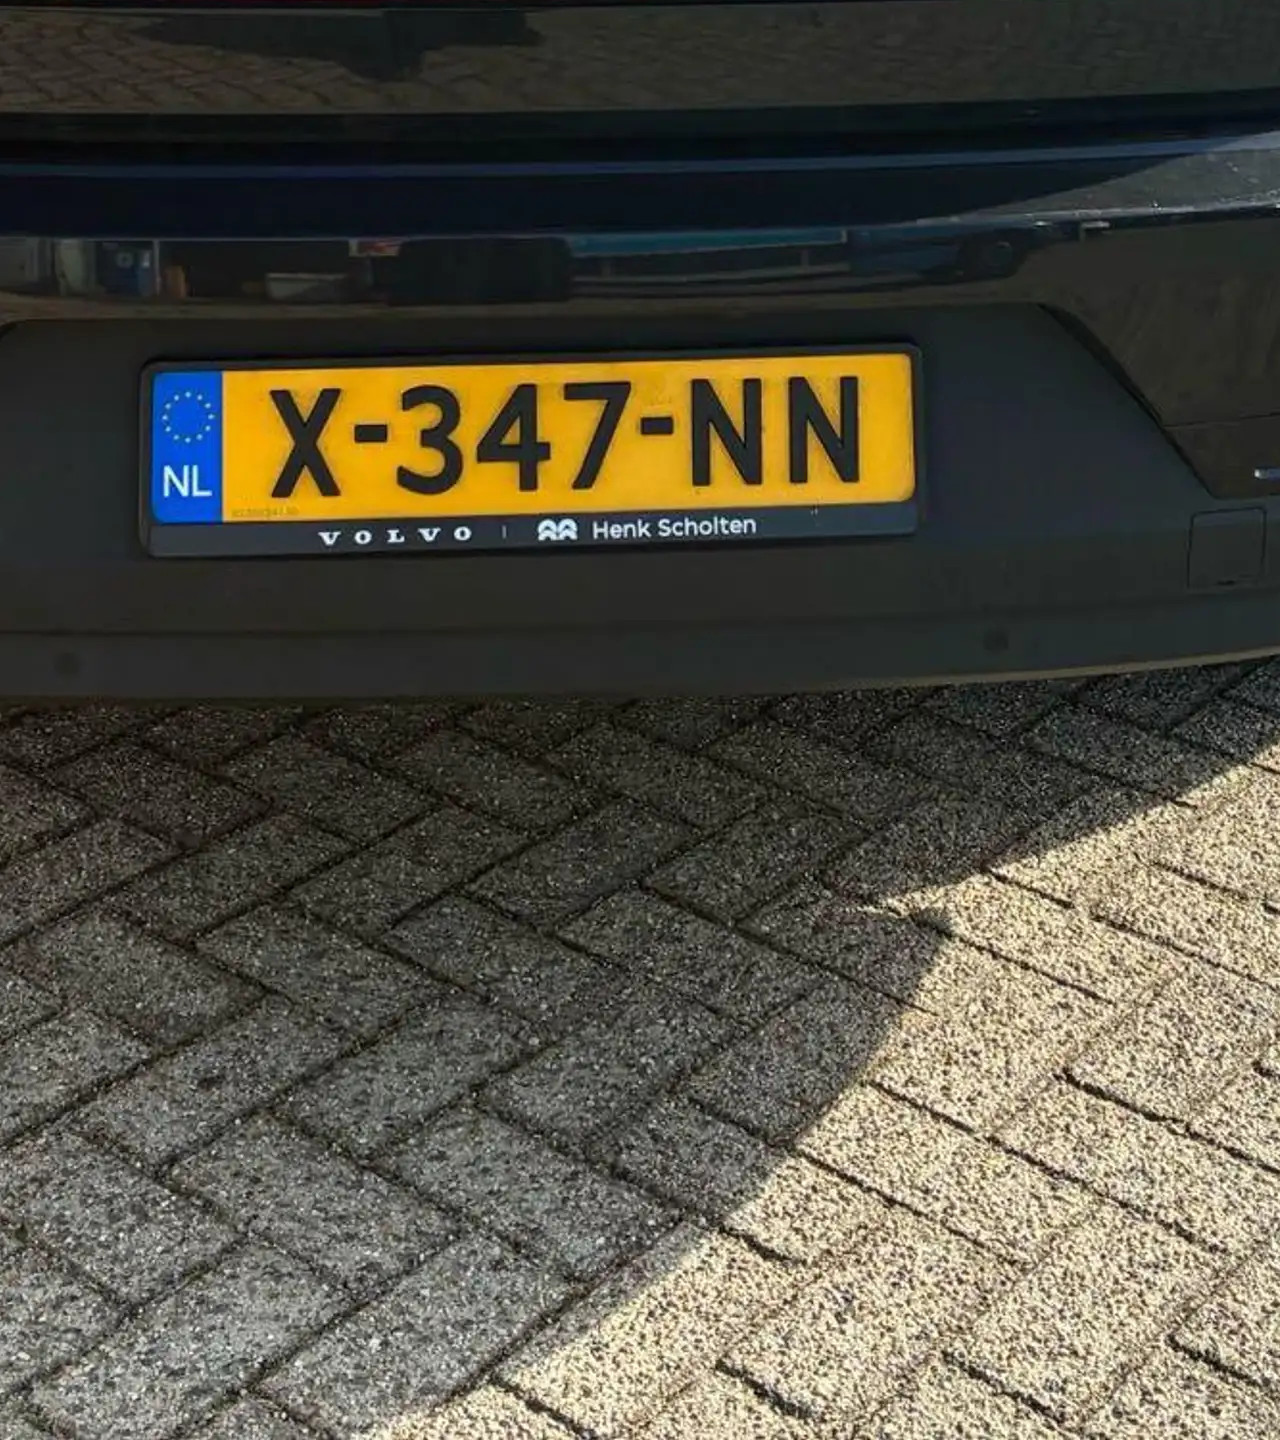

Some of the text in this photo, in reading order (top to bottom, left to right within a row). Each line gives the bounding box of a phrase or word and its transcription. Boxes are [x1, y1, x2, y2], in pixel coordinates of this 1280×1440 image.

[269, 375, 860, 499] X-347-NN
[162, 464, 213, 498] NL
[318, 516, 767, 546] VOLVO Henk Scholten
